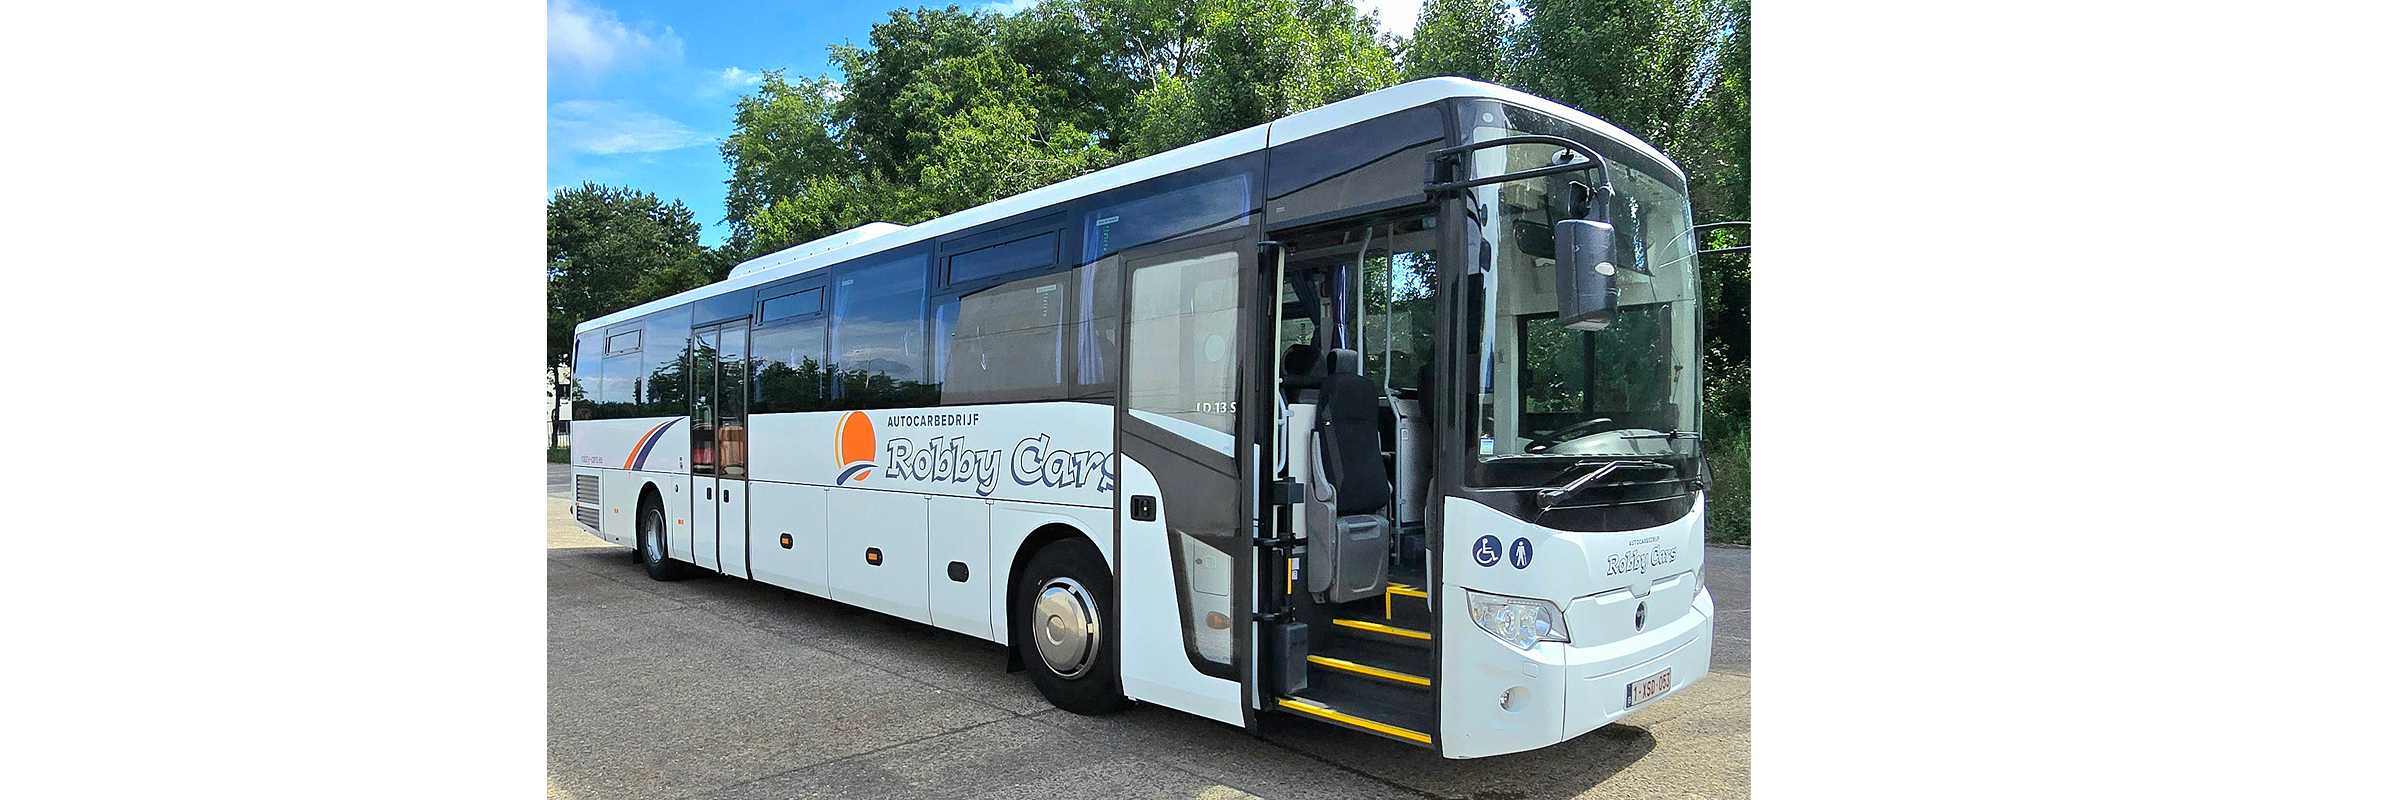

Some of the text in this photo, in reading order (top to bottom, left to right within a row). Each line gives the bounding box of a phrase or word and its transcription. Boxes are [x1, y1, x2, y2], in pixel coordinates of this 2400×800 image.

[1215, 402, 1227, 414] 13
[887, 413, 980, 428] AUTOCARBEDRIJF
[886, 435, 1001, 497] Robby
[1606, 544, 1678, 576] Robby Cars
